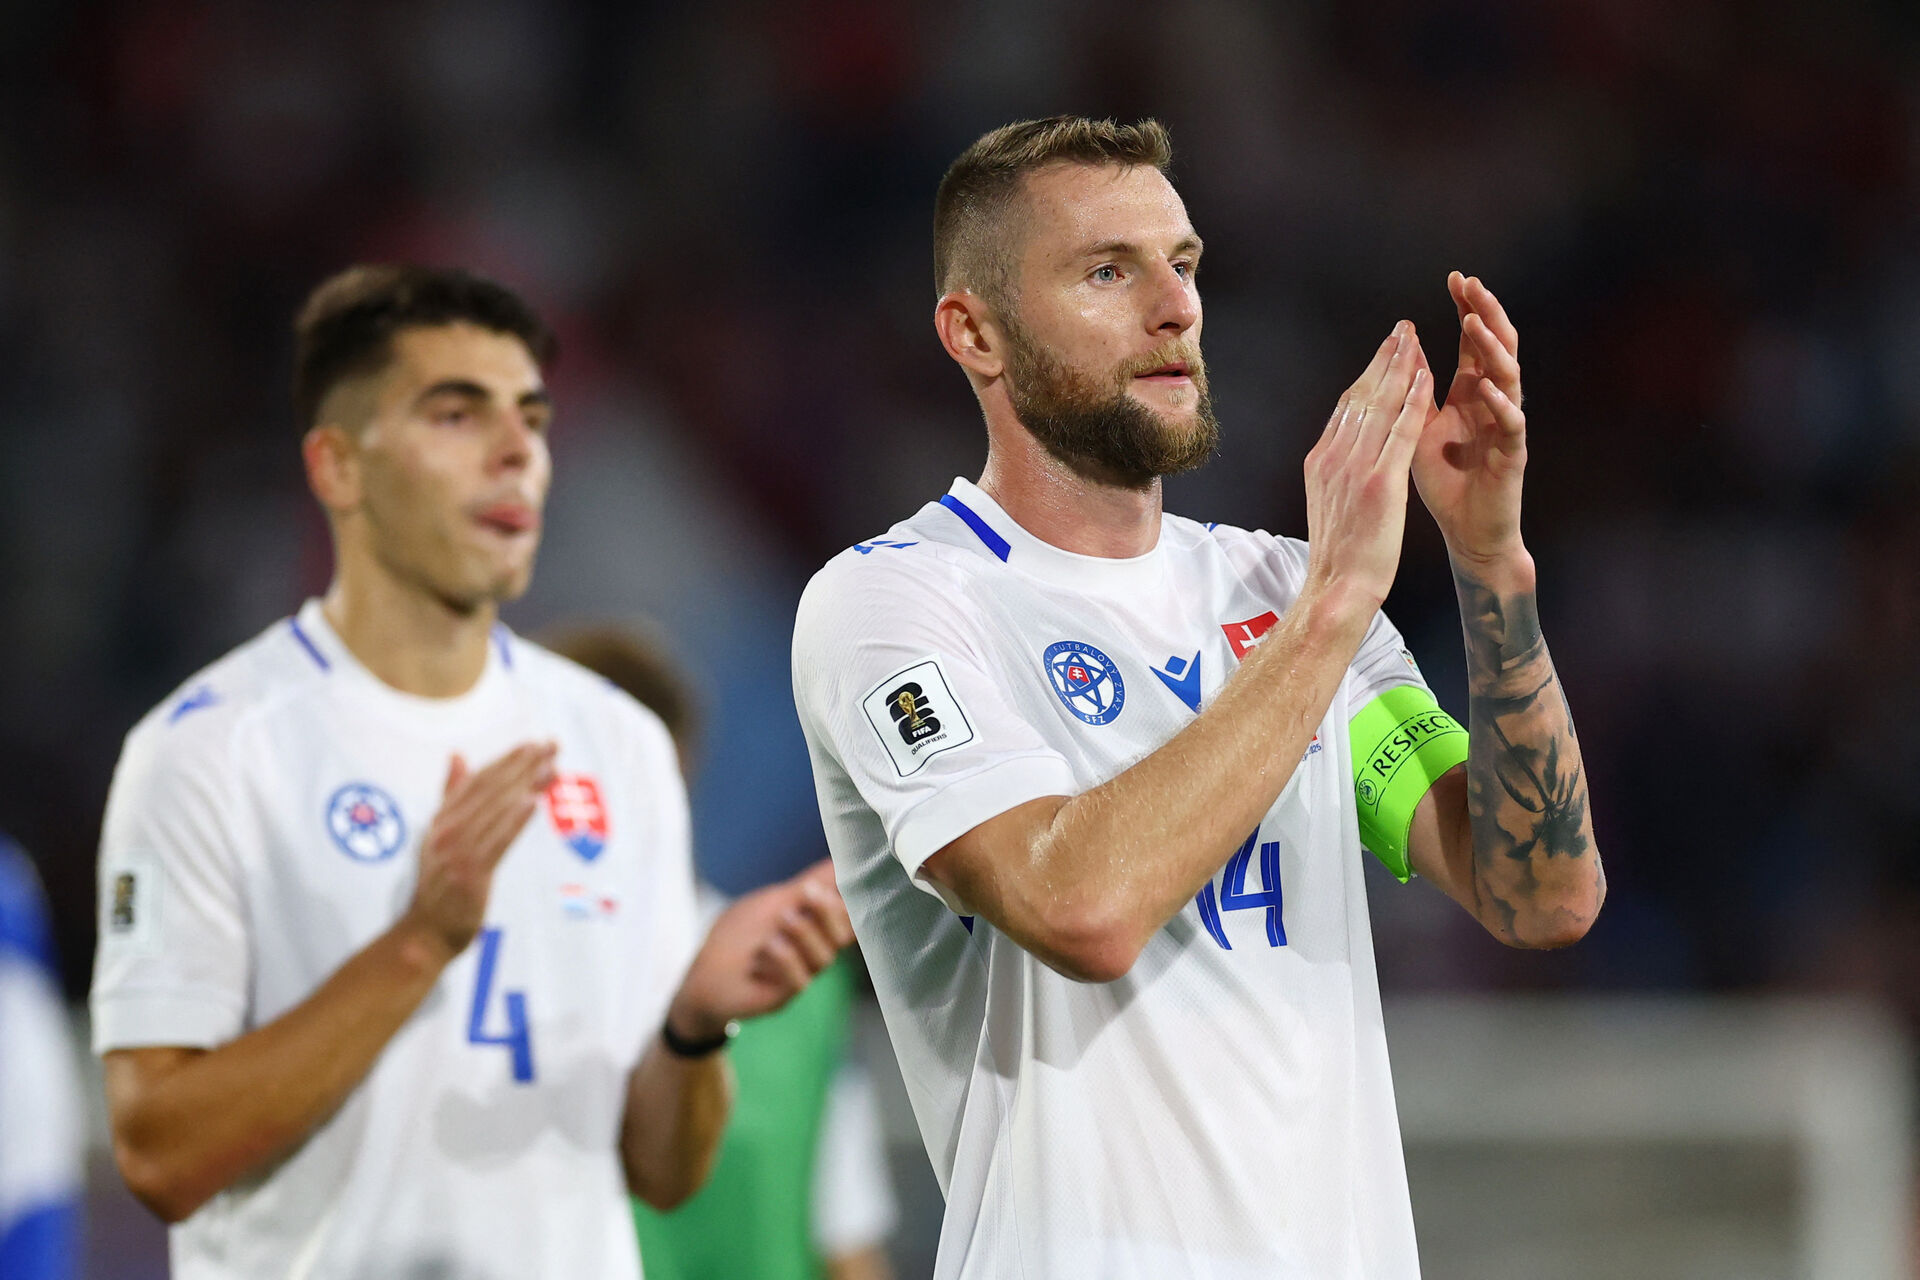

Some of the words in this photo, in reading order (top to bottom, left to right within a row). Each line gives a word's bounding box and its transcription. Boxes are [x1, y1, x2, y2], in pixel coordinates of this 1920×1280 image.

[911, 725, 932, 738] FIFA
[1084, 715, 1106, 724] SFZ
[911, 733, 947, 756] QUALIFIERS
[1372, 715, 1457, 777] RESPECT
[1195, 822, 1288, 951] 14
[467, 926, 535, 1084] 4
